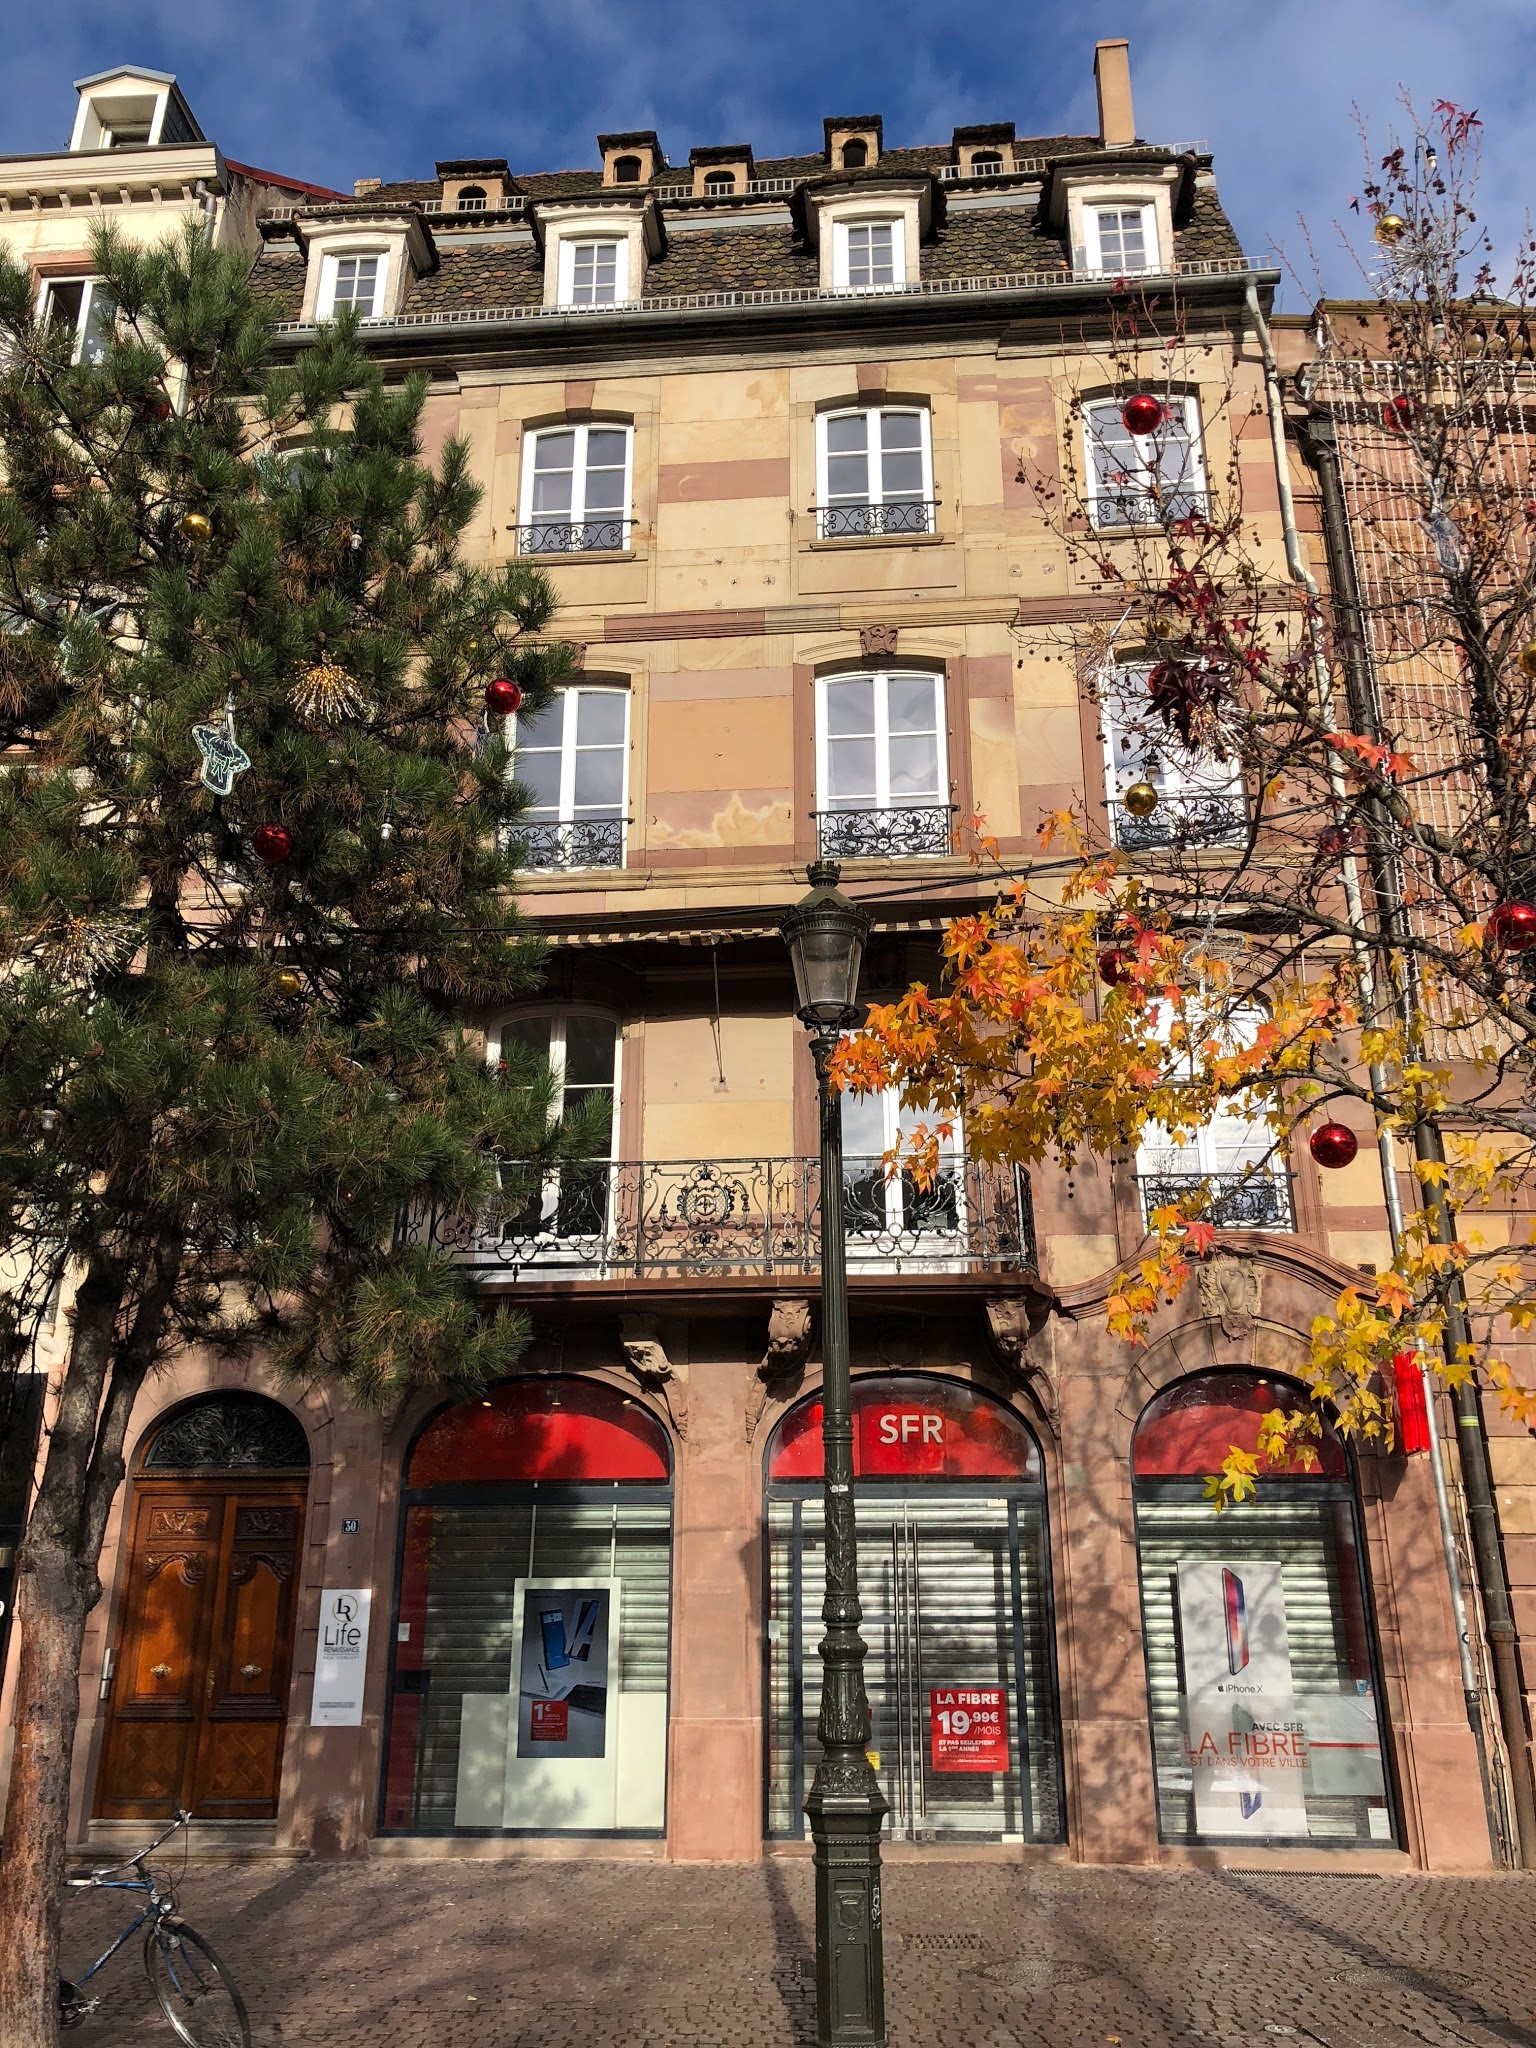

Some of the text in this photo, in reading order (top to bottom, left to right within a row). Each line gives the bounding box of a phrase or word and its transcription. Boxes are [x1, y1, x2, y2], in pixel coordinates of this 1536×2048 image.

[879, 1414, 944, 1444] SFR
[345, 1520, 357, 1532] 30
[324, 1623, 361, 1646] Life
[1226, 1684, 1264, 1693] iPhone X
[936, 1693, 1000, 1705] LA FIBRE
[1252, 1722, 1304, 1732] AVEC SFR
[1184, 1732, 1307, 1756] LA FIBRE
[1208, 1757, 1237, 1767] DANS
[1241, 1758, 1276, 1767] VOTRE
[1278, 1758, 1309, 1768] VILLE
